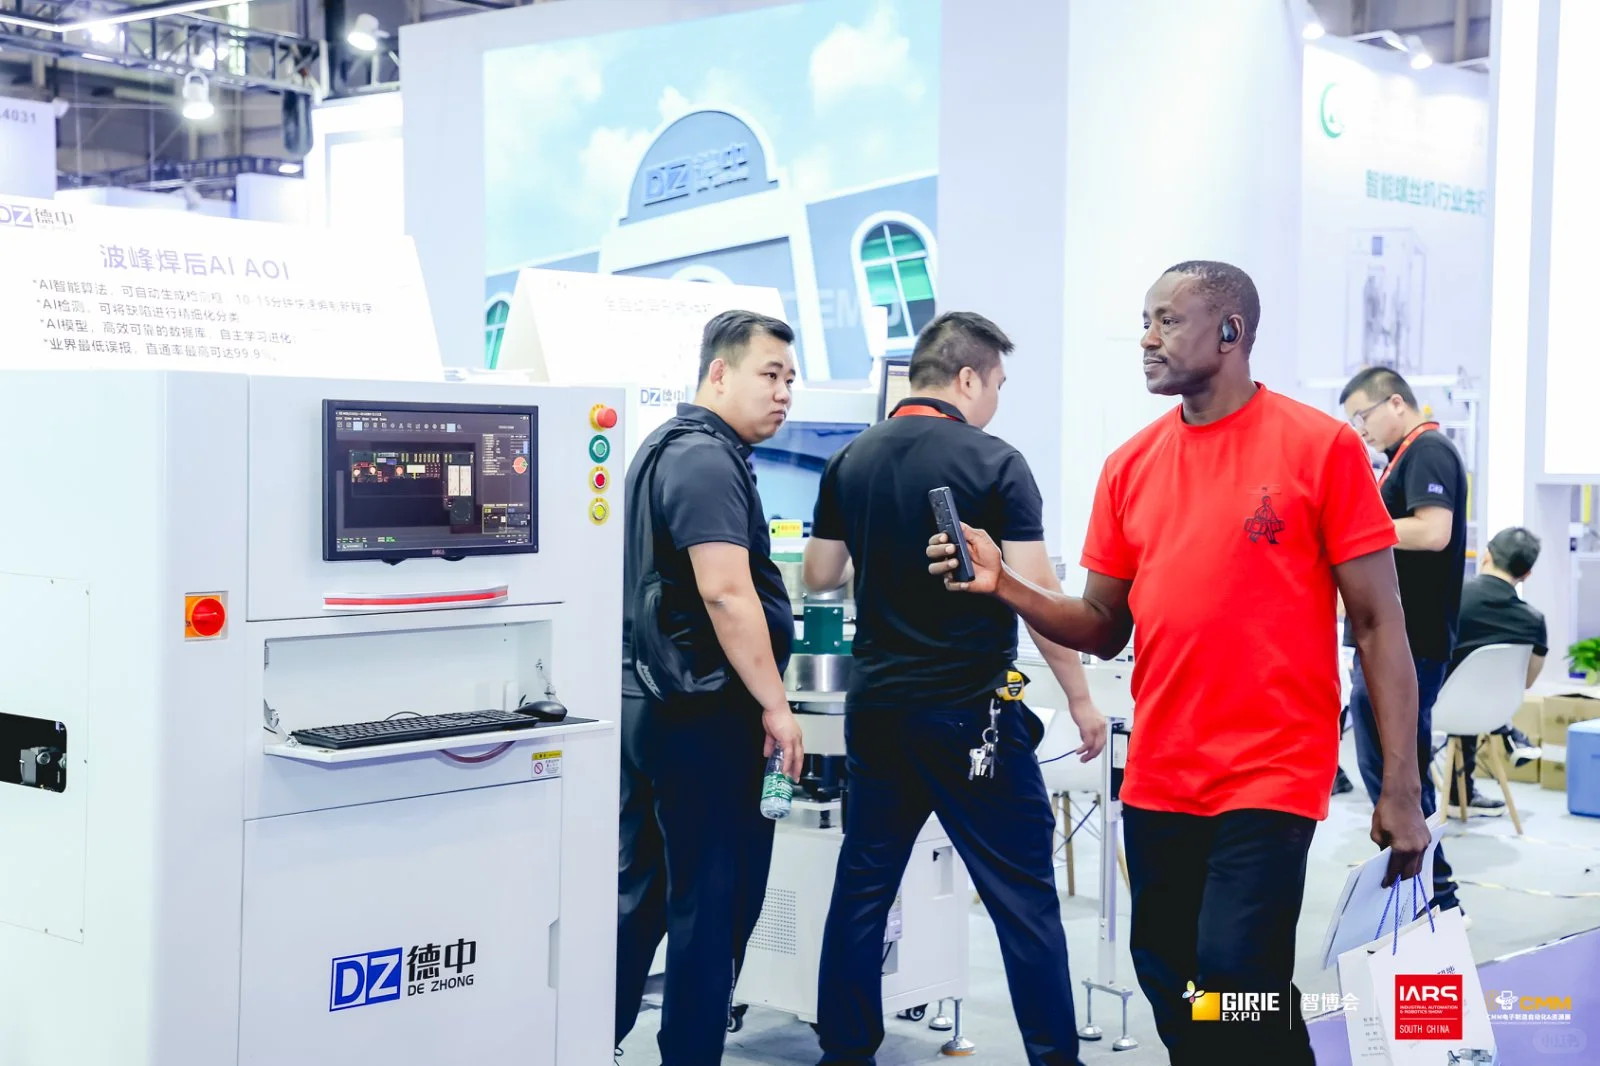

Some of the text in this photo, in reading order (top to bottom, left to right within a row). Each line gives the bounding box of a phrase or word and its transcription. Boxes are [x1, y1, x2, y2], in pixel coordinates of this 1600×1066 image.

[99, 243, 290, 281] 波峰焊后AI AOI
[330, 938, 477, 1010] DZ 德中
[407, 974, 474, 996] DE ZHONG
